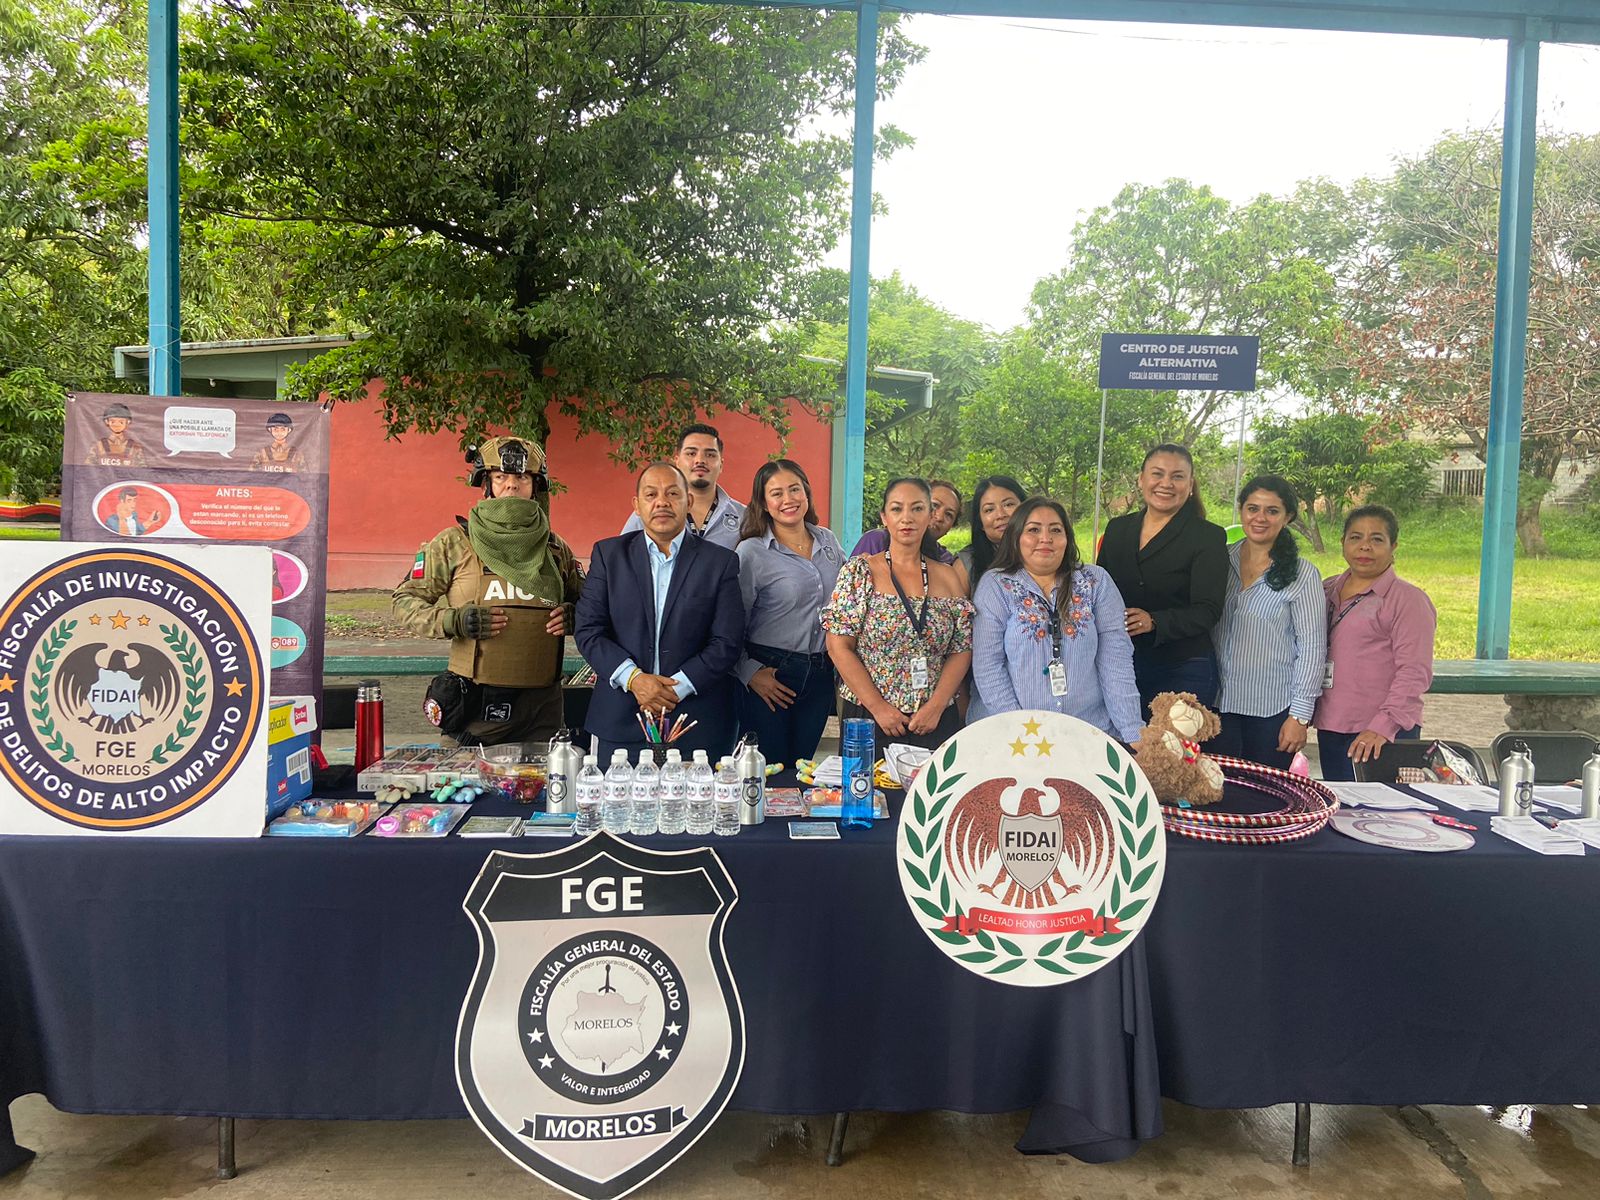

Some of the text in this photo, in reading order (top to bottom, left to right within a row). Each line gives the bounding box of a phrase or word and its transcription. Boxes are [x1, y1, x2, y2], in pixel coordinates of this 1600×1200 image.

[1120, 343, 1239, 355] CENTRO DE JUSTICIA
[1138, 357, 1218, 369] ALTERNATIVA
[1148, 372, 1167, 380] GENERAL
[1167, 372, 1175, 380] DEL
[1175, 372, 1191, 381] ESTADO
[1192, 373, 1198, 381] DE
[101, 458, 121, 466] UECS
[264, 465, 284, 473] UECS
[216, 488, 253, 498] ANTES:
[0, 572, 239, 673] FISCALÍA DE INVESTIGACIÓN
[281, 638, 297, 646] 089
[92, 689, 136, 703] FIDAI
[96, 741, 136, 758] FGE
[3, 732, 74, 799] DELITOS
[76, 788, 104, 809] DE
[110, 785, 167, 810] ALTO
[168, 706, 242, 794] IMPACTO
[82, 764, 150, 776] MORELOS
[1005, 831, 1056, 848] FIDAI
[1006, 852, 1055, 862] MORELOS
[561, 876, 645, 913] FGE
[978, 913, 1086, 929] LEALTAD HONOR JUSTICIA
[530, 940, 681, 1016] FISCALÍA GENERAL DEL ESTADO
[570, 970, 580, 978] una
[580, 962, 595, 972] mejor
[596, 959, 629, 968] procuración
[629, 964, 636, 972] de
[634, 969, 650, 986] justicia
[574, 1018, 633, 1031] MORELOS
[560, 1073, 589, 1094] VALOR
[597, 1069, 651, 1096] INTEGRIDAD
[545, 1113, 657, 1138] MORELOS
